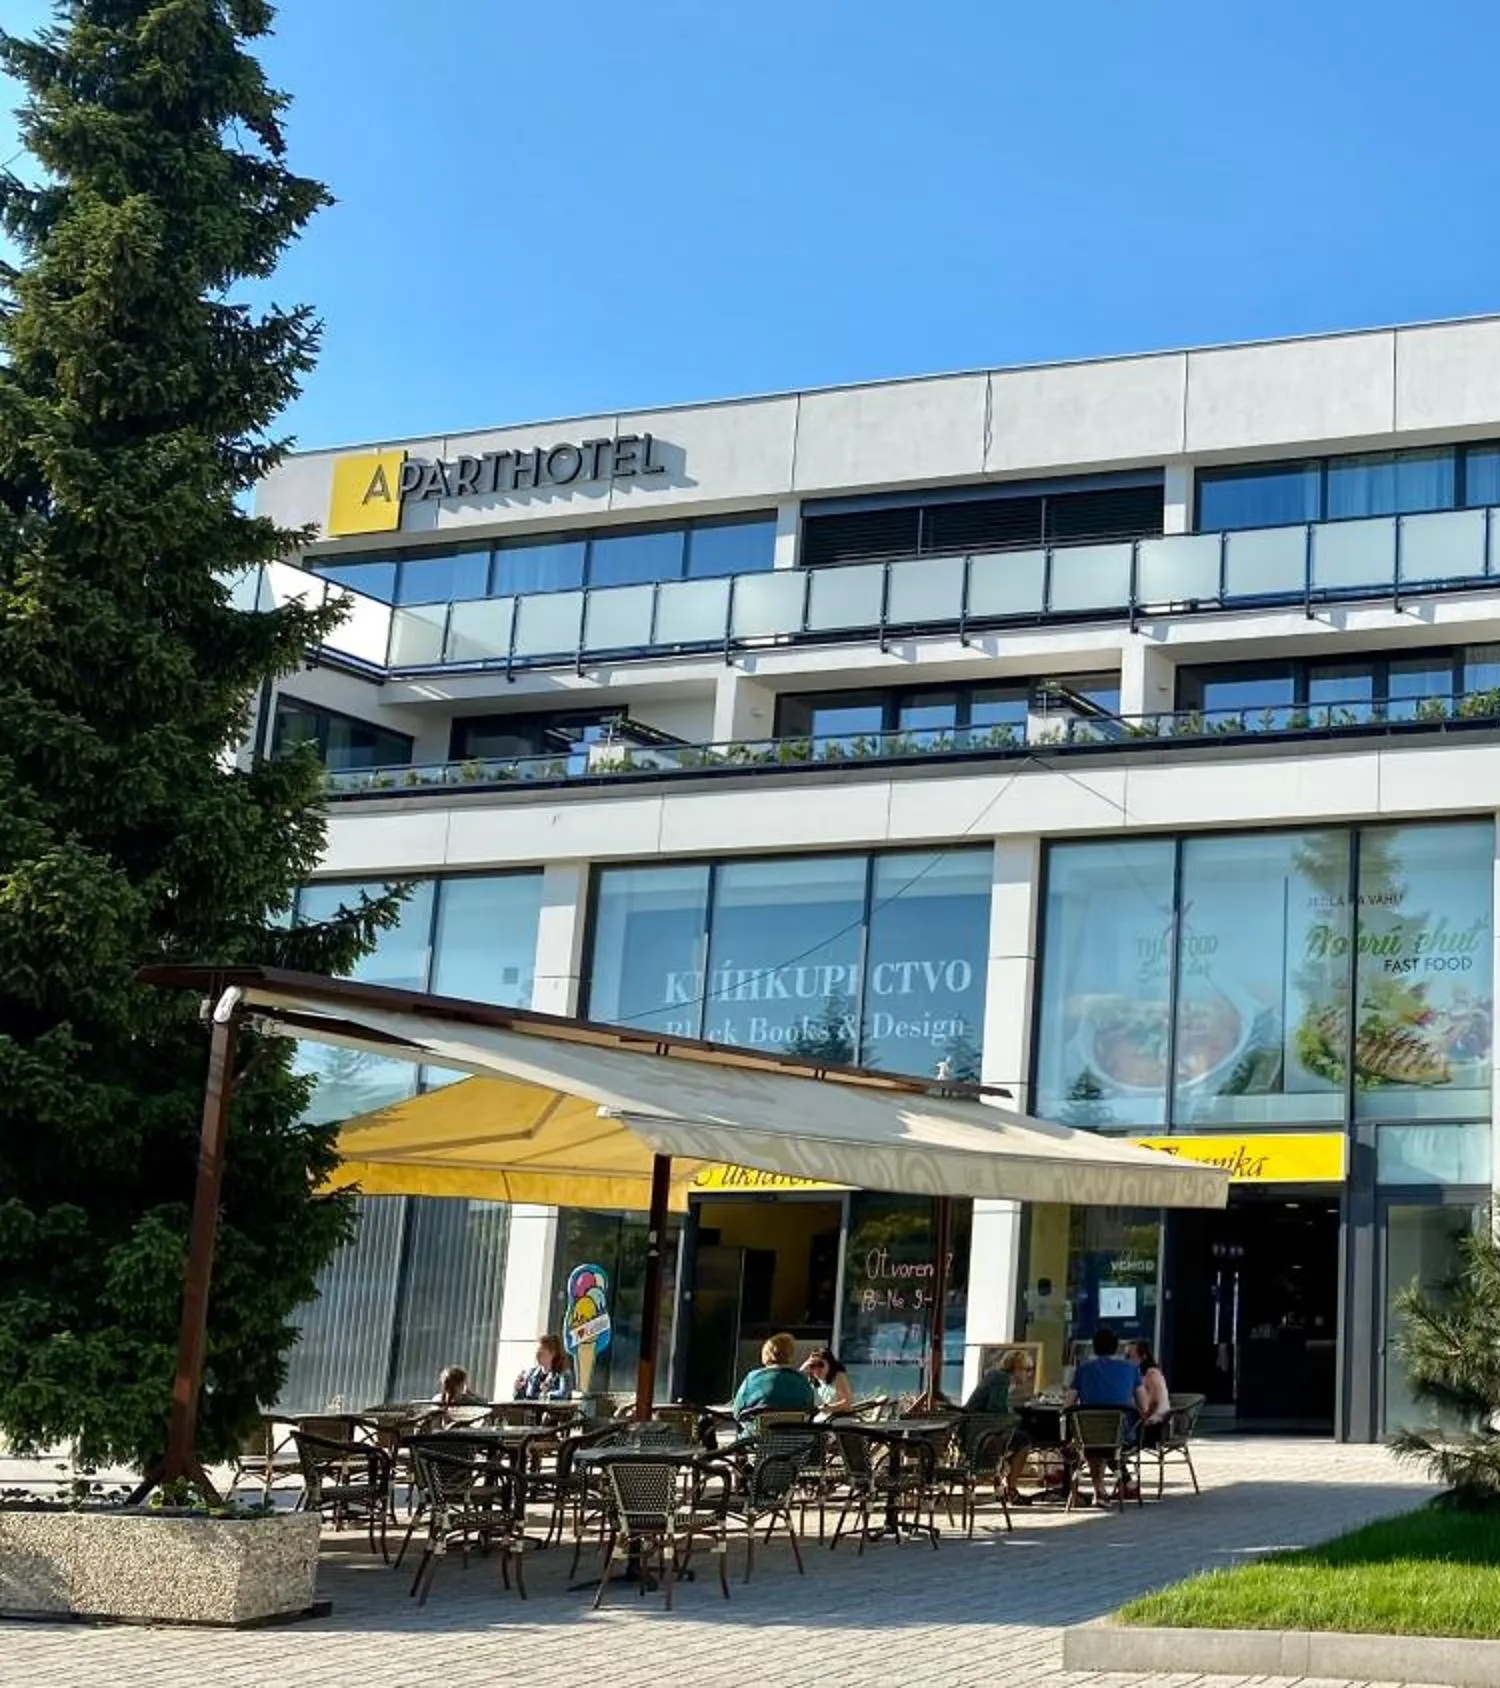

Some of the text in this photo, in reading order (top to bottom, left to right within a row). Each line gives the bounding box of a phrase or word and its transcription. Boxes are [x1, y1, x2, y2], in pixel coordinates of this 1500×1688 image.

[361, 432, 666, 506] APARTHOTEL
[1383, 956, 1473, 973] FAST FOOD
[664, 1018, 737, 1045] Blck
[749, 1016, 830, 1046] Books
[871, 1010, 965, 1046] Design
[865, 1247, 942, 1280] Otvoren
